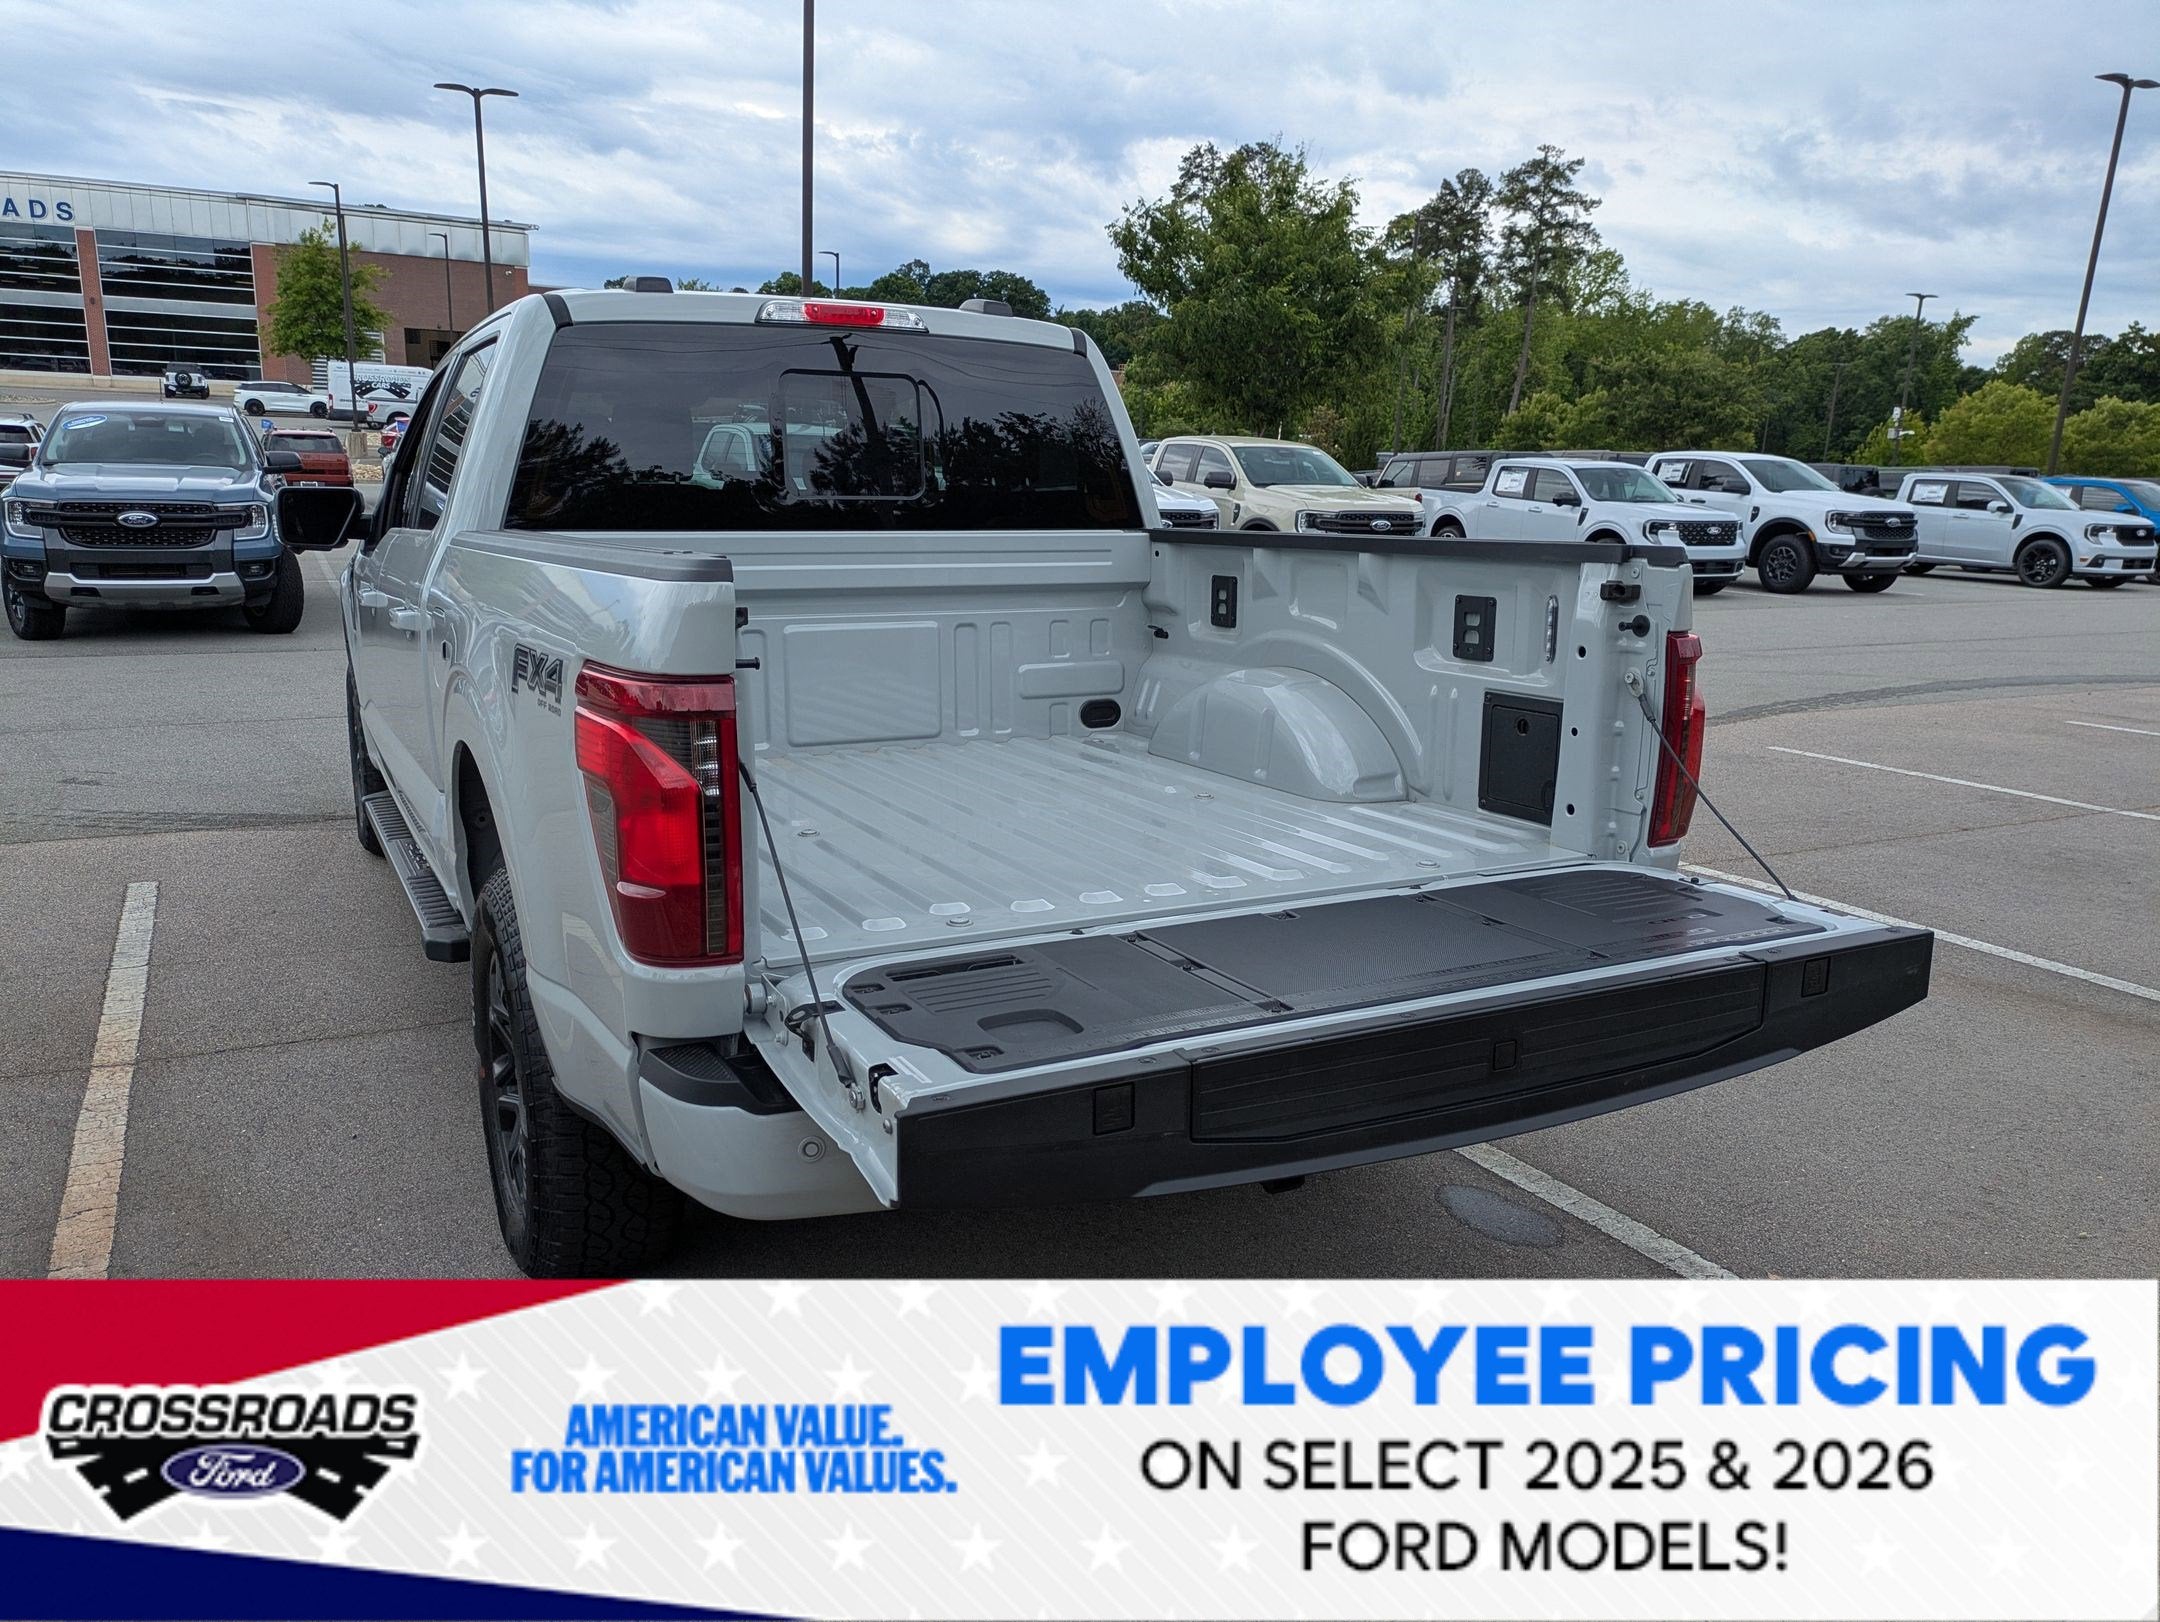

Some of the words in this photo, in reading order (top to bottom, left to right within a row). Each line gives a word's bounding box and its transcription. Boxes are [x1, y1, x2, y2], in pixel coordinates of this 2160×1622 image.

[2, 197, 74, 221] ADS
[355, 373, 411, 384] ROSSROADS
[511, 643, 563, 705] FX4
